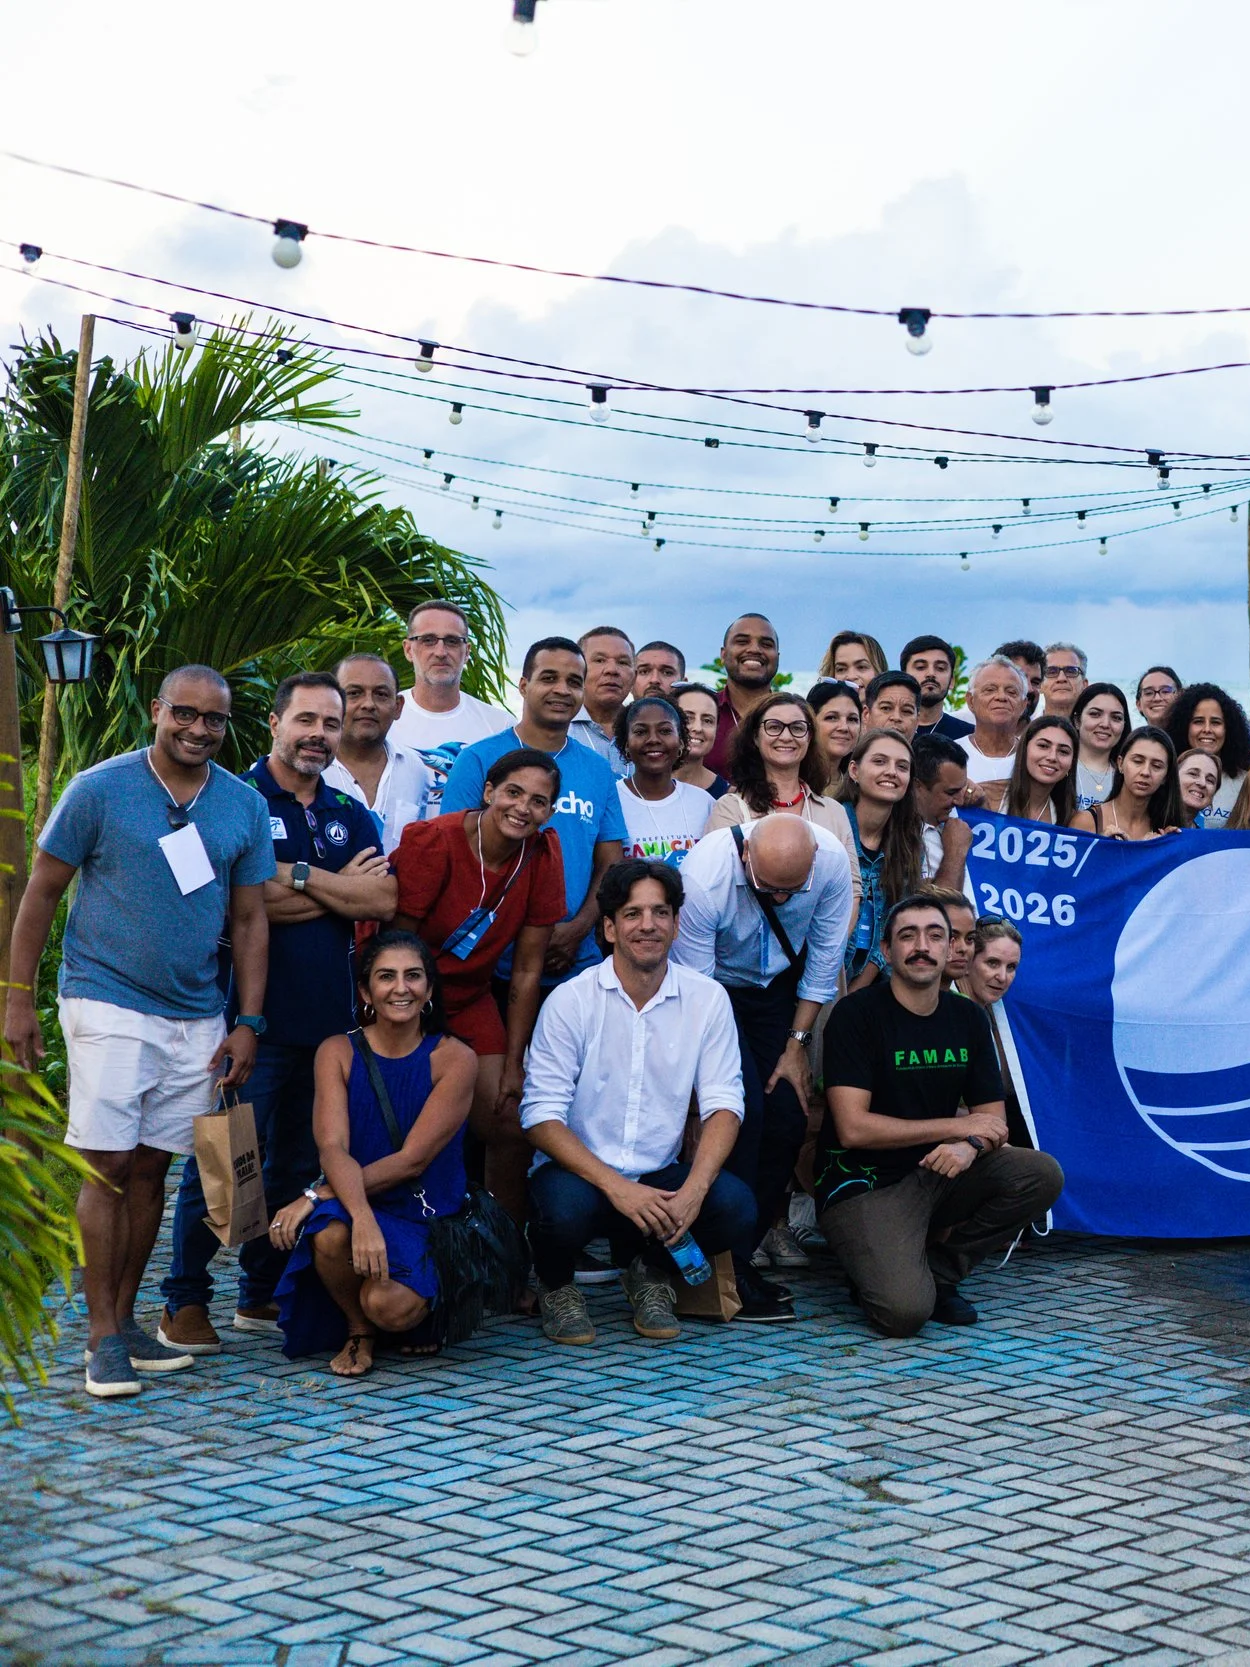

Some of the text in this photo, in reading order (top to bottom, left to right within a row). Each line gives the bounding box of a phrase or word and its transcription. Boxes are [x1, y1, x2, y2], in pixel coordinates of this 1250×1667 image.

[636, 833, 694, 842] PREFEITURA
[971, 822, 1100, 877] 2025/
[980, 882, 1076, 926] 2026
[895, 1048, 968, 1065] FAMAB
